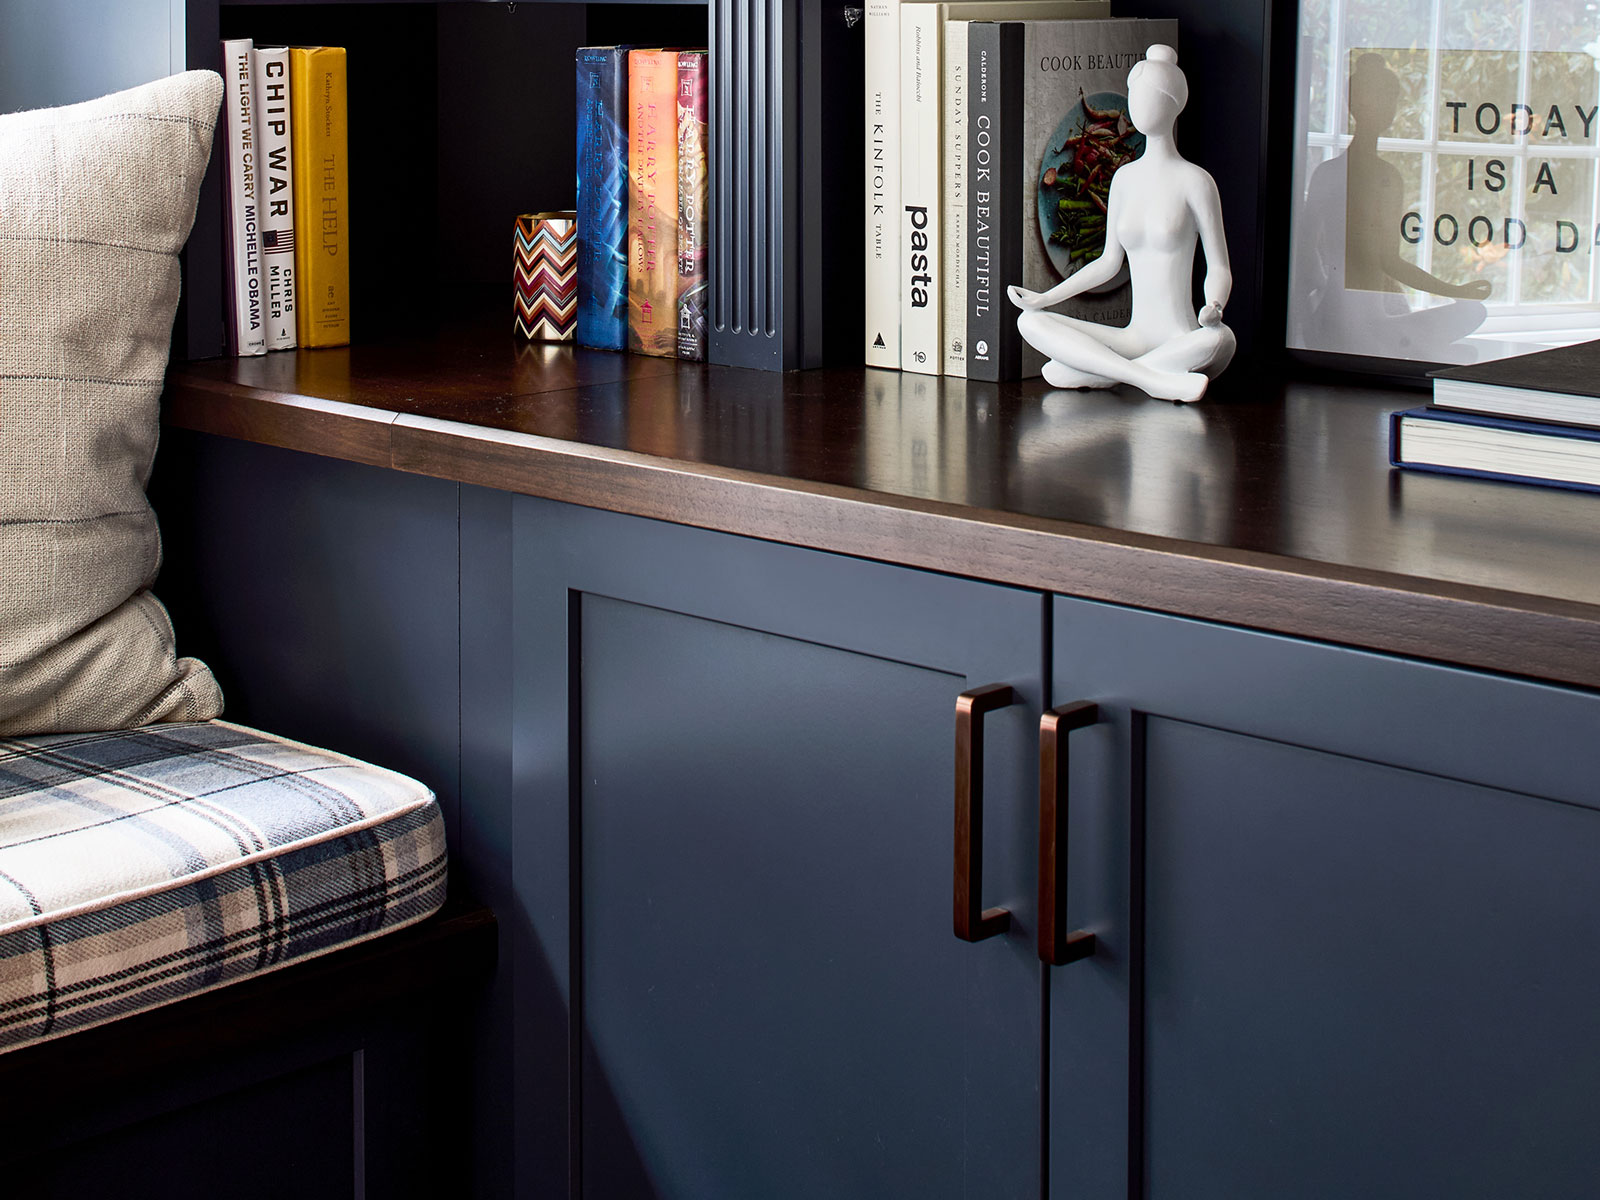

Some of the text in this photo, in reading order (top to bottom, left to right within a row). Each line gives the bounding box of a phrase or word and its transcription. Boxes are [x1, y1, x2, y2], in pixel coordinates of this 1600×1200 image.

[238, 53, 249, 80] THE
[324, 72, 332, 104] Kathryn
[1040, 53, 1147, 72] COOK BEAUTI
[239, 84, 251, 125] LIGHT
[954, 65, 962, 126] SUNDAY
[1446, 102, 1600, 138] TODAY
[241, 128, 252, 150] WE
[266, 61, 289, 217] CHIP WAR
[595, 100, 604, 177] HARRY
[647, 103, 657, 184] HARRY
[685, 105, 697, 188] HARRY
[873, 124, 884, 215] KINFOLK
[954, 134, 962, 198] SUPPERS
[976, 115, 991, 182] COOK
[242, 153, 255, 200] CARRY
[322, 154, 338, 256] THE HELP
[637, 102, 645, 273] AND THE DEATHLY HALLOWS
[1468, 159, 1558, 195] IS A
[244, 205, 258, 275] MICHELLE
[646, 194, 657, 272] POTTER
[685, 194, 696, 274] POTTER
[905, 205, 932, 308] pasta
[976, 191, 991, 317] BEAUTIFUL
[1400, 211, 1527, 250] GOOD
[248, 278, 260, 331] OBAMA
[270, 265, 281, 319] MILLER
[283, 268, 293, 312] CHRIS
[1093, 308, 1131, 320] CALDER
